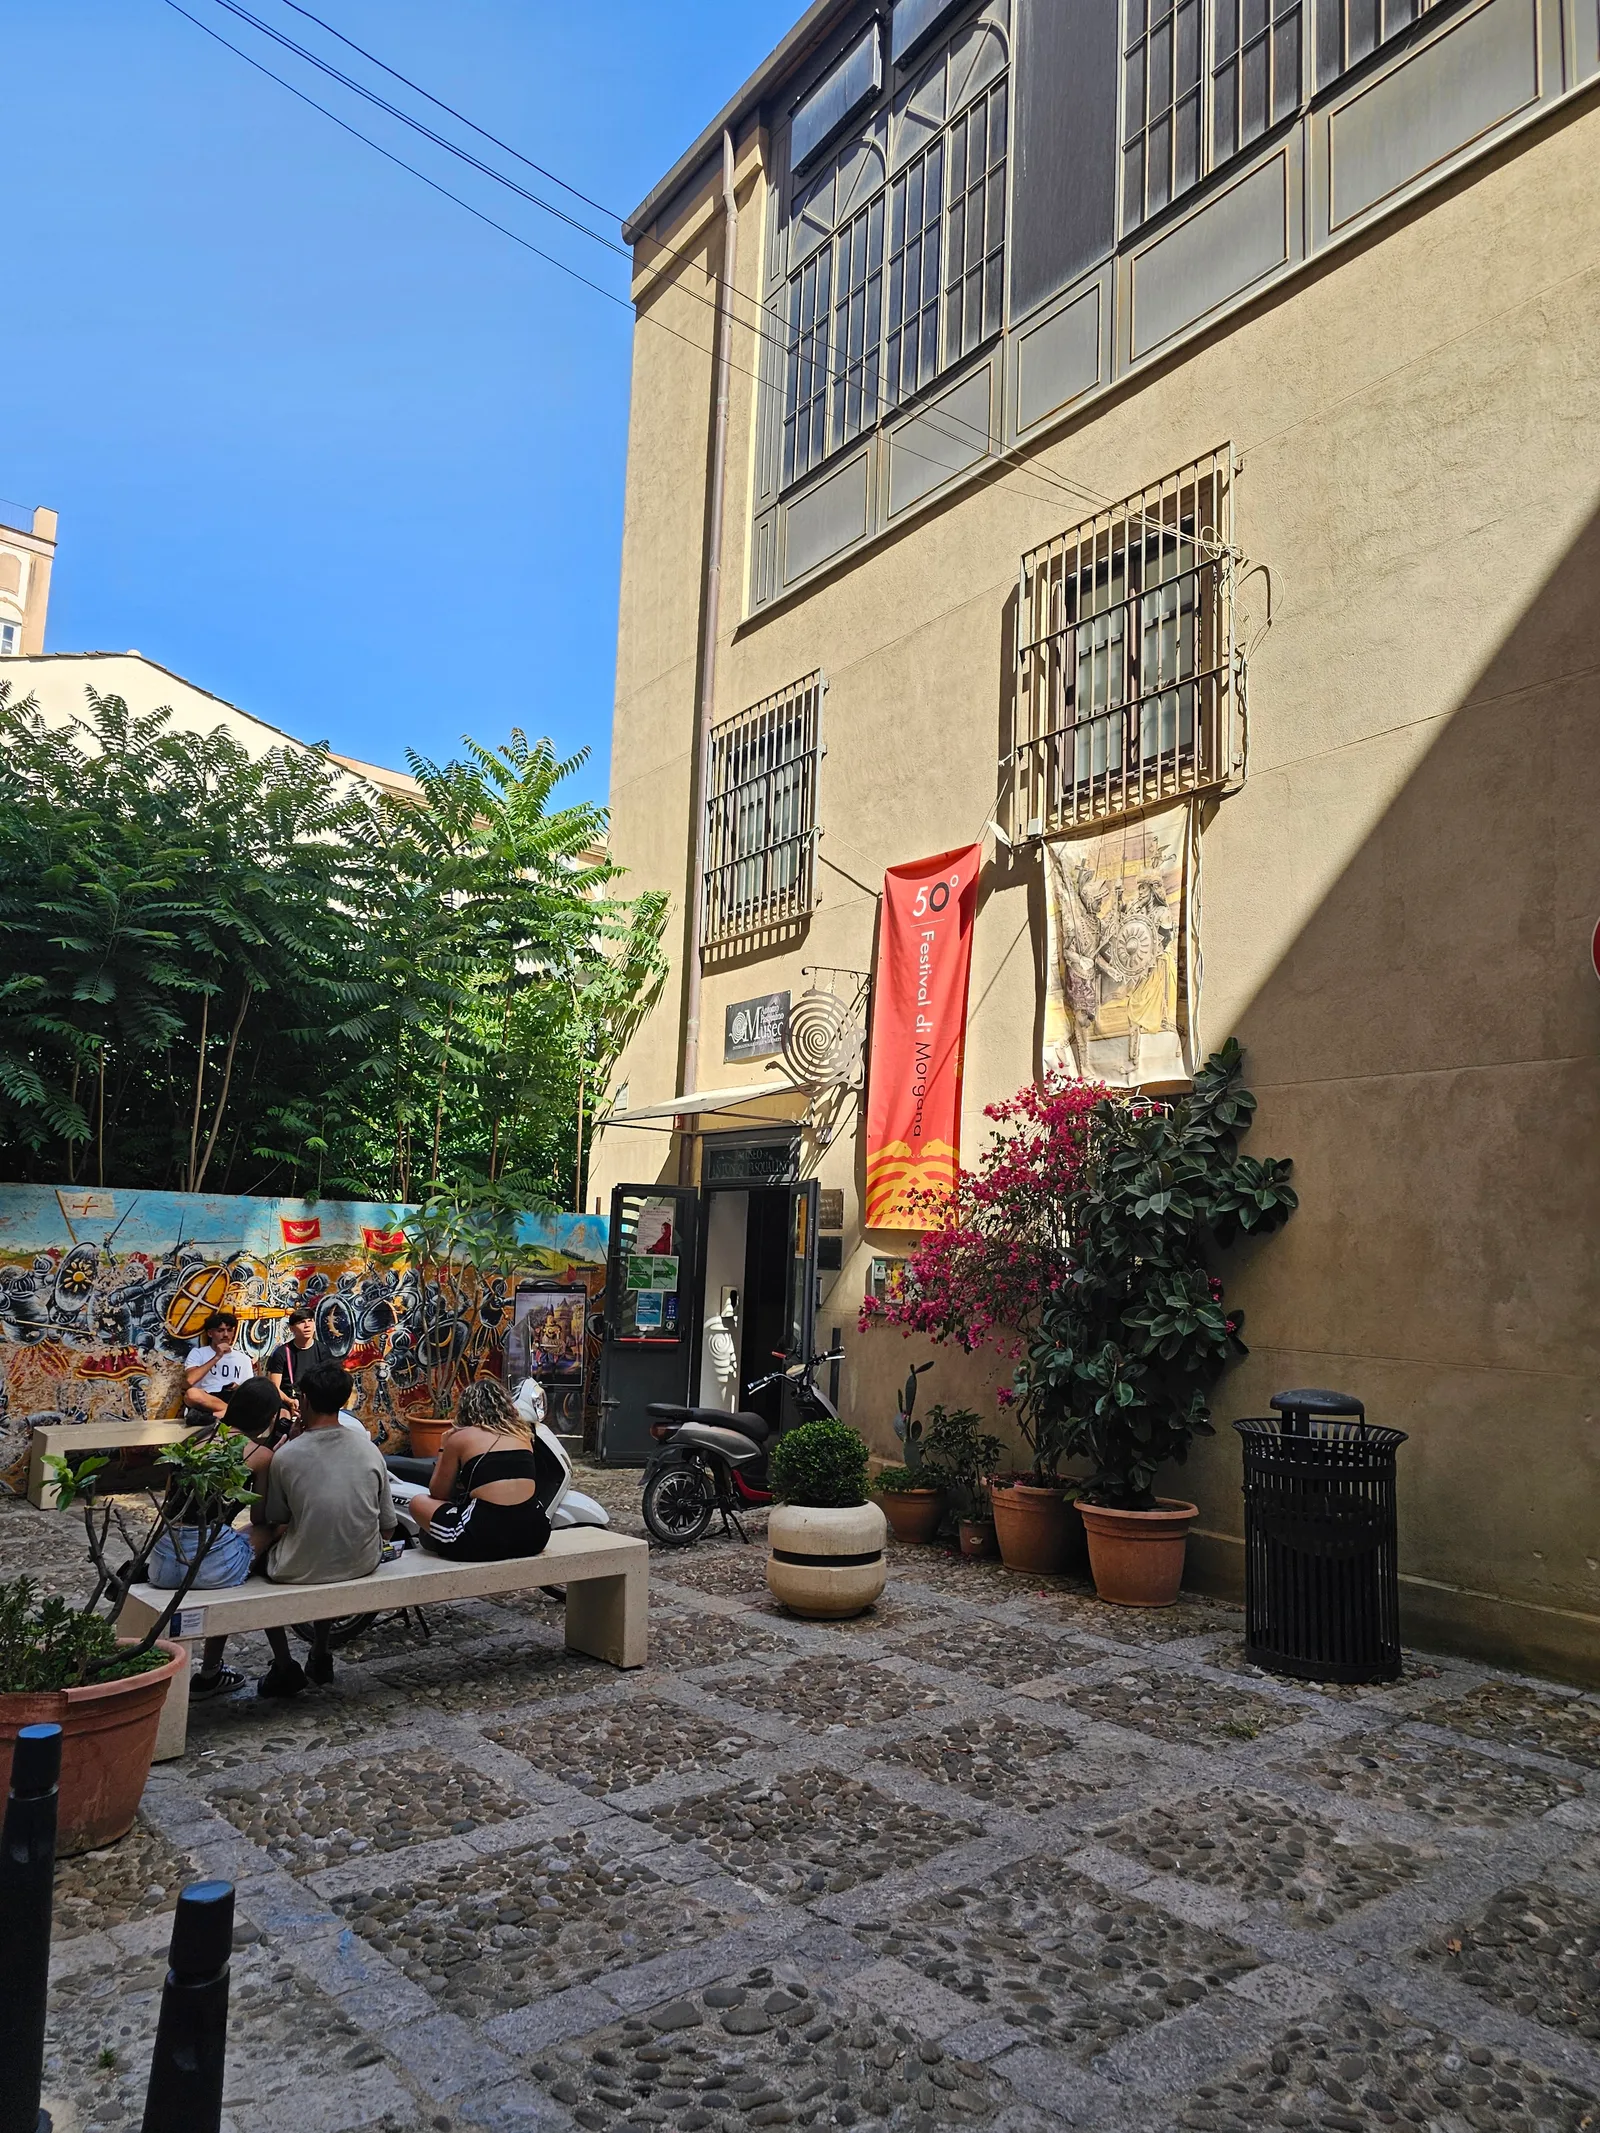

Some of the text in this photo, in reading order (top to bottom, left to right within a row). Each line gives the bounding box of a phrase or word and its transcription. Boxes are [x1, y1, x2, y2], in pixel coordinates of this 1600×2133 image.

[912, 930, 935, 1137] Festival di Morgana
